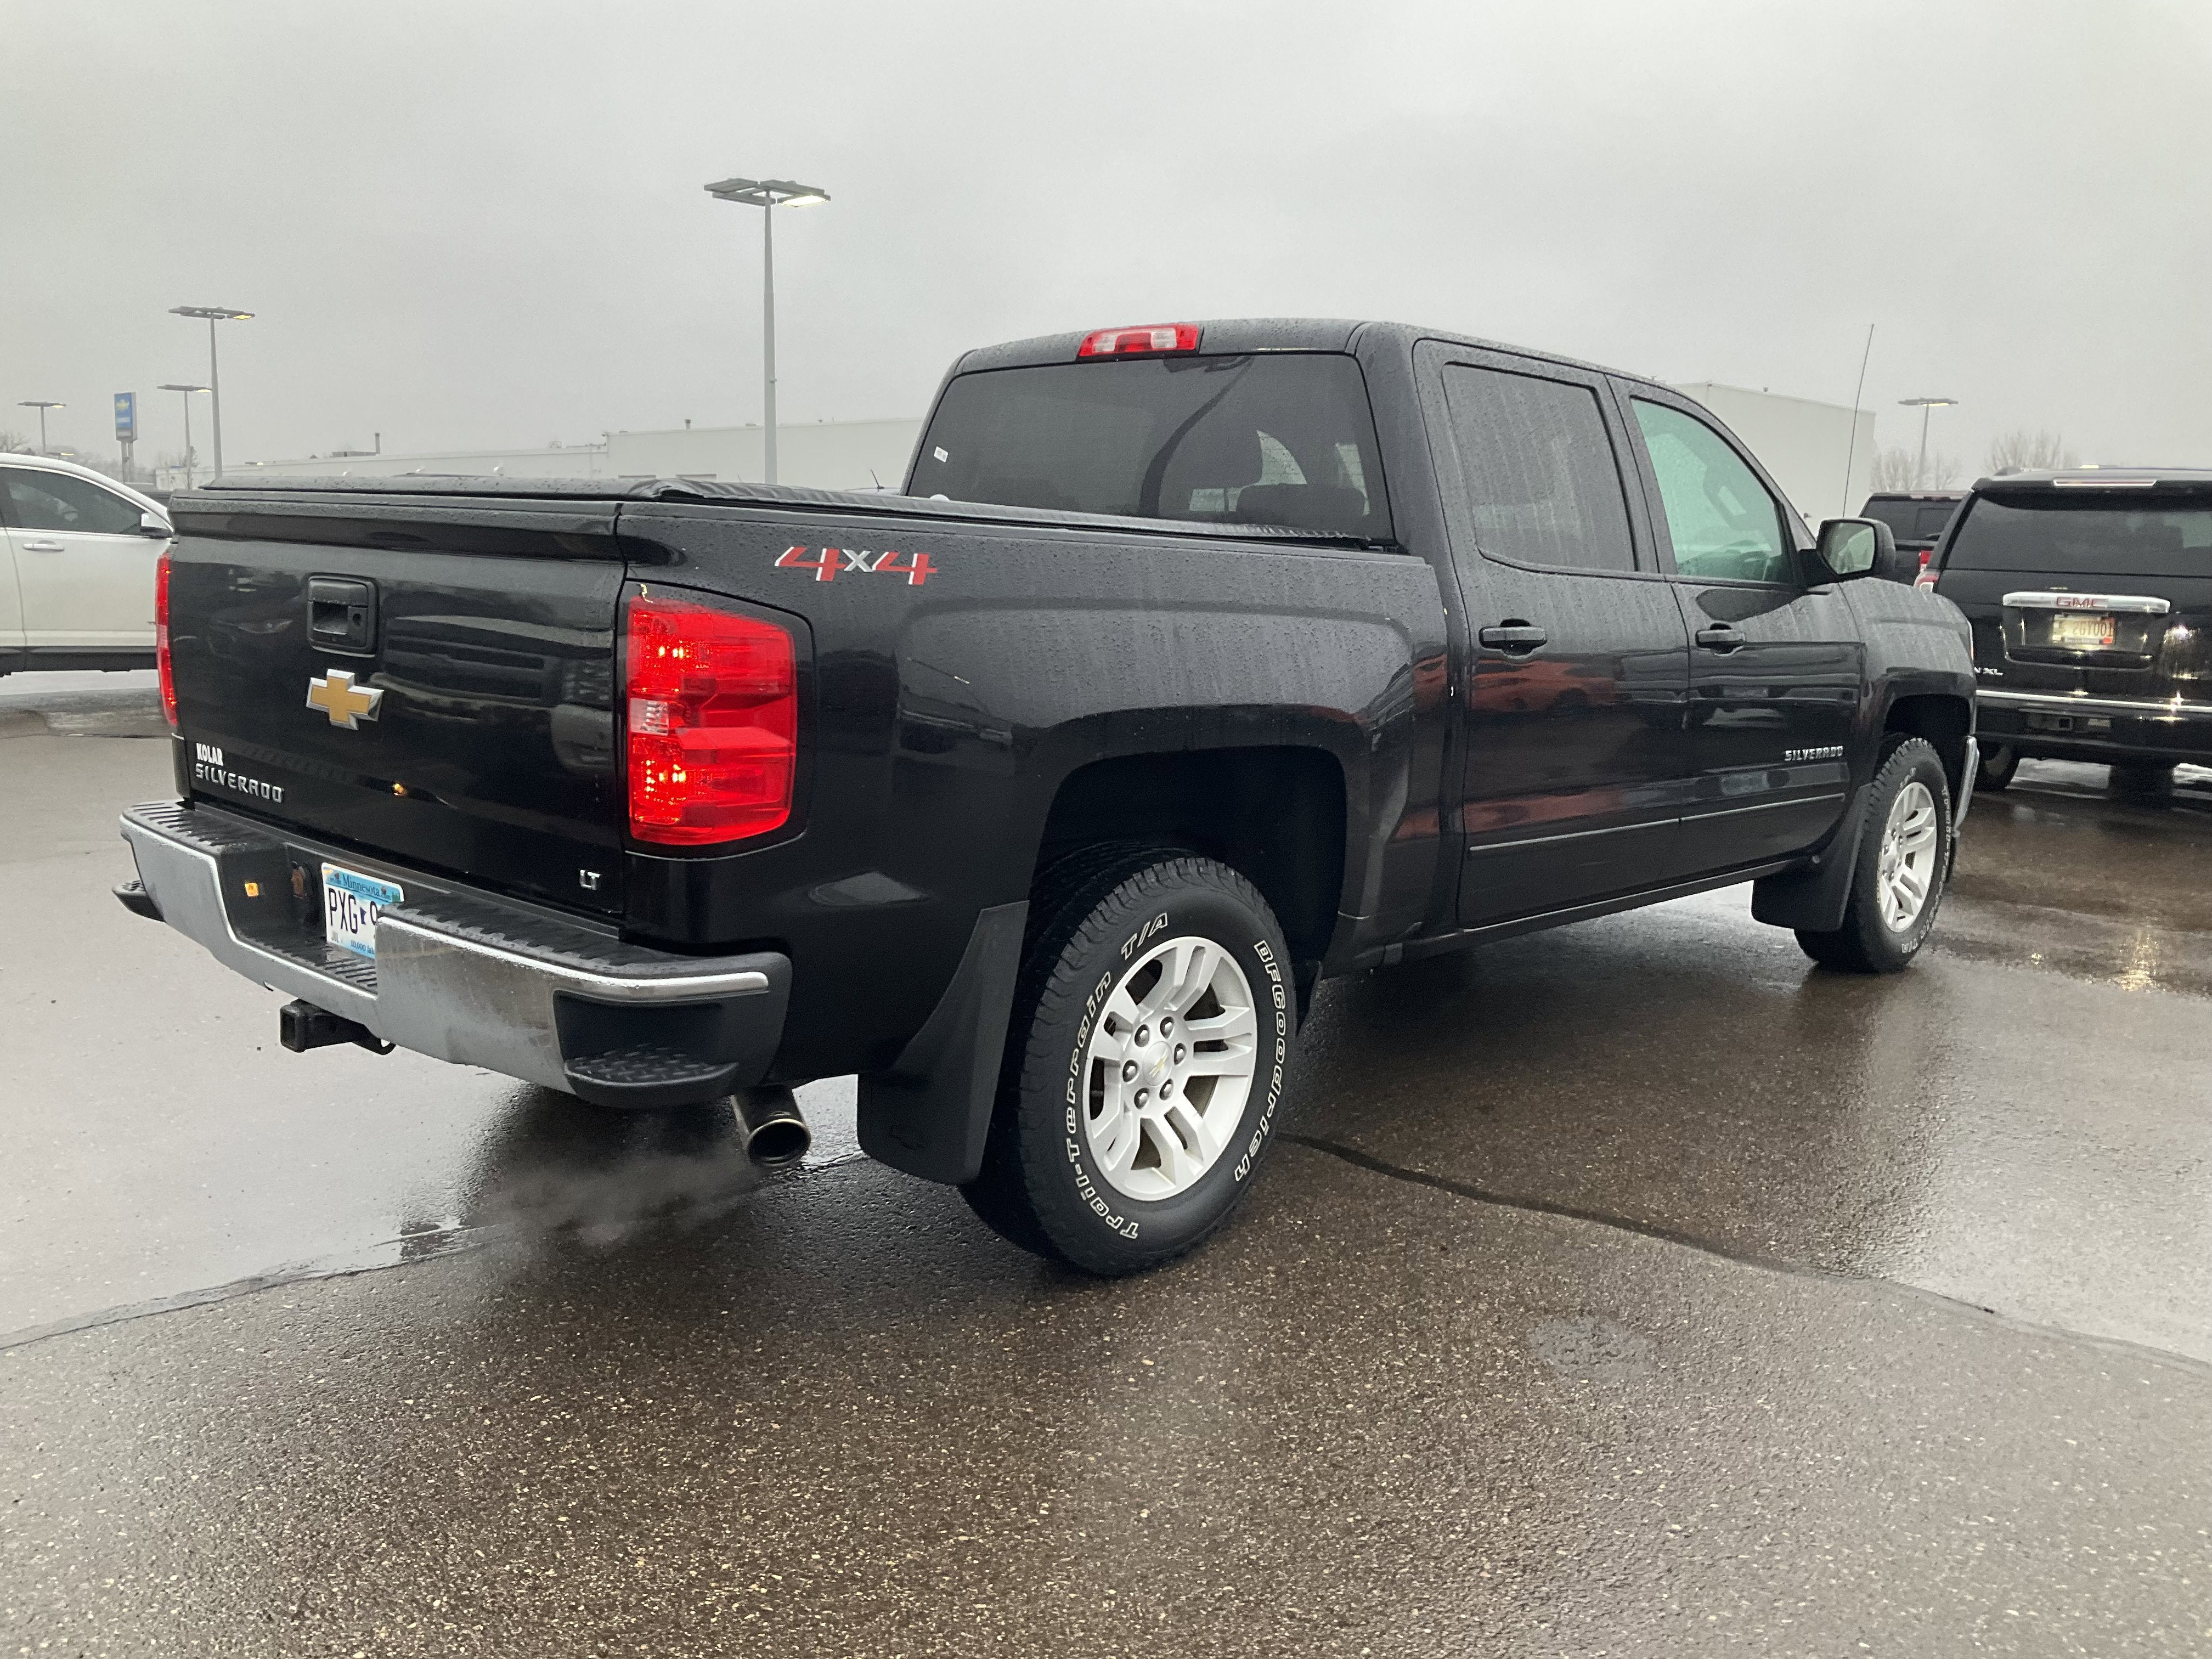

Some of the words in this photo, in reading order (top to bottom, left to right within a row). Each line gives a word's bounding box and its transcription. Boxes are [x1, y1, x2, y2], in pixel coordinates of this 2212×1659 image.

[2057, 596, 2108, 609] GMC
[196, 742, 223, 766] KOLAR
[1784, 746, 1844, 761] SILVERADO
[195, 763, 283, 803] SILVERADO
[343, 873, 380, 897] Minnesota
[579, 870, 601, 890] LT
[328, 887, 358, 934] PXG
[1066, 970, 1138, 1239] Trail-Terrain
[1120, 912, 1169, 961] T/A
